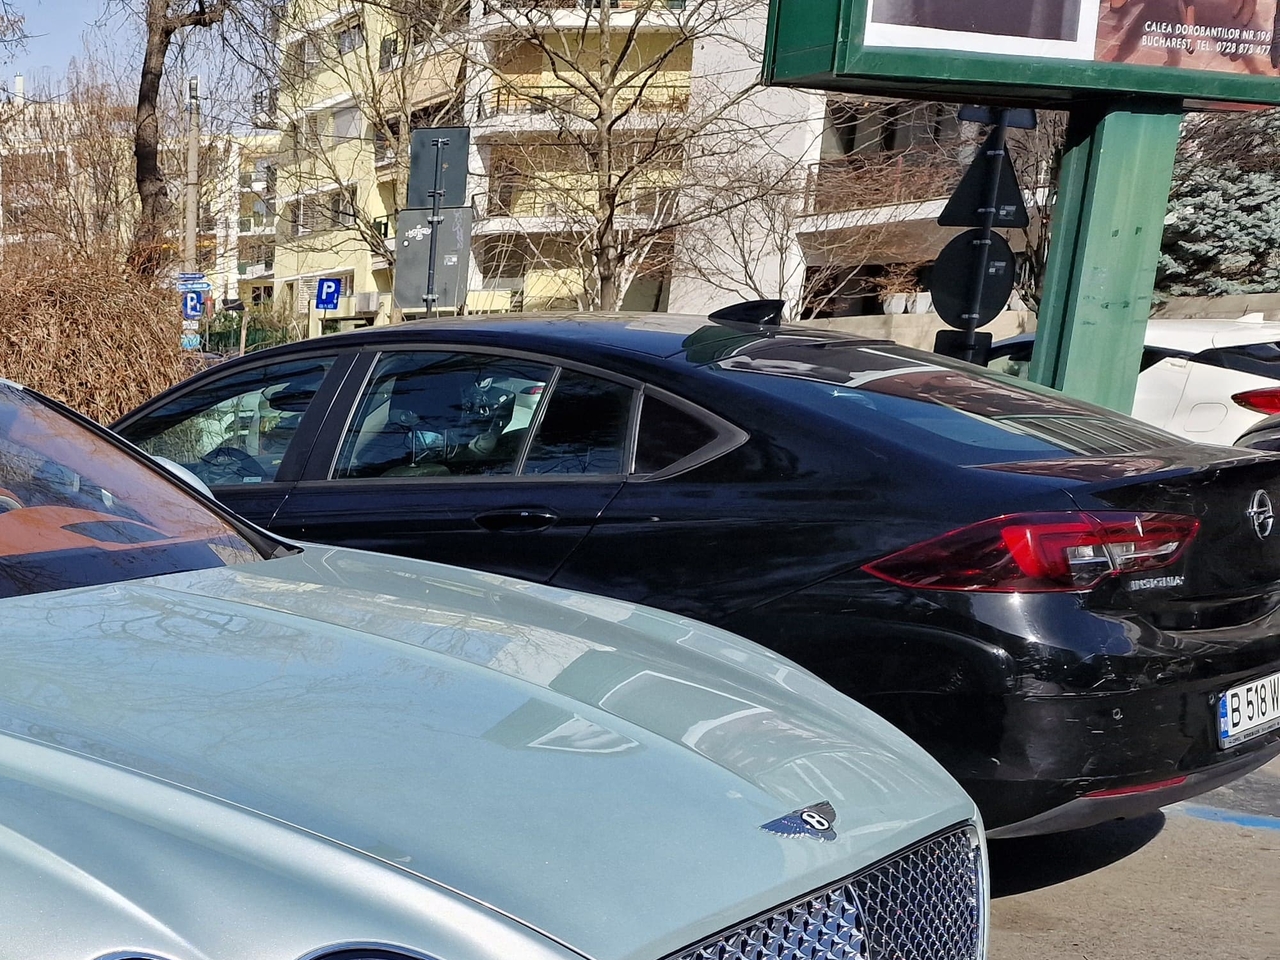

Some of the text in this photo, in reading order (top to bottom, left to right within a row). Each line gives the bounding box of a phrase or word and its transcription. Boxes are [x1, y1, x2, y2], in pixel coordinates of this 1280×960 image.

[1144, 20, 1172, 33] CALEA
[1175, 23, 1240, 39] DOROBANTILOR
[1141, 35, 1271, 55] BUCHAREST, TEL. 0728 873 477
[1230, 692, 1241, 729] B
[1246, 683, 1268, 722] 518
